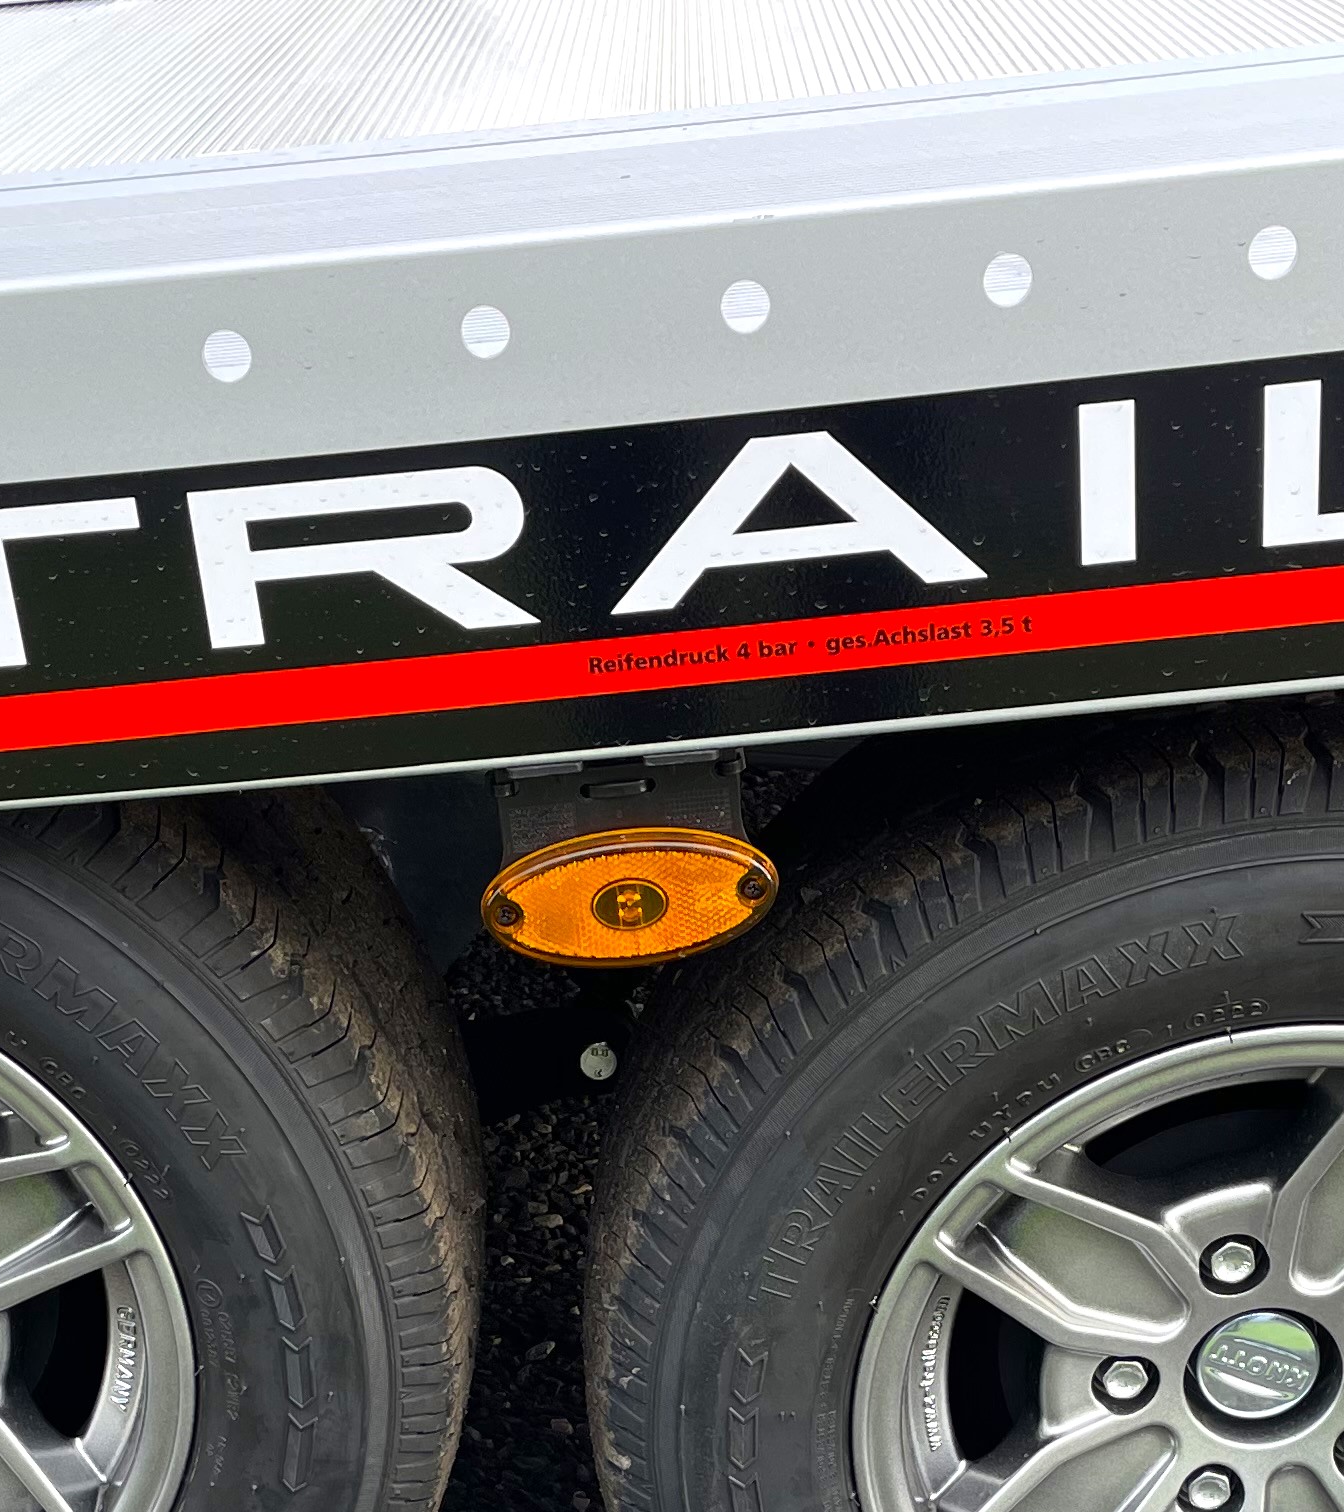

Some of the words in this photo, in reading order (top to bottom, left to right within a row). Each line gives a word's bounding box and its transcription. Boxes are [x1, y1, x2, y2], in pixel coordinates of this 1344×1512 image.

[587, 644, 731, 676] Reifendruck
[736, 642, 752, 661] 4
[758, 639, 798, 659] bar
[826, 621, 973, 656] ges.Achslast
[980, 618, 1016, 639] 3,5
[1020, 615, 1034, 634] t
[747, 912, 1244, 1299] TRAILERMAXX
[109, 1306, 134, 1412] GERMANY
[1209, 1344, 1311, 1391] KNOTT
